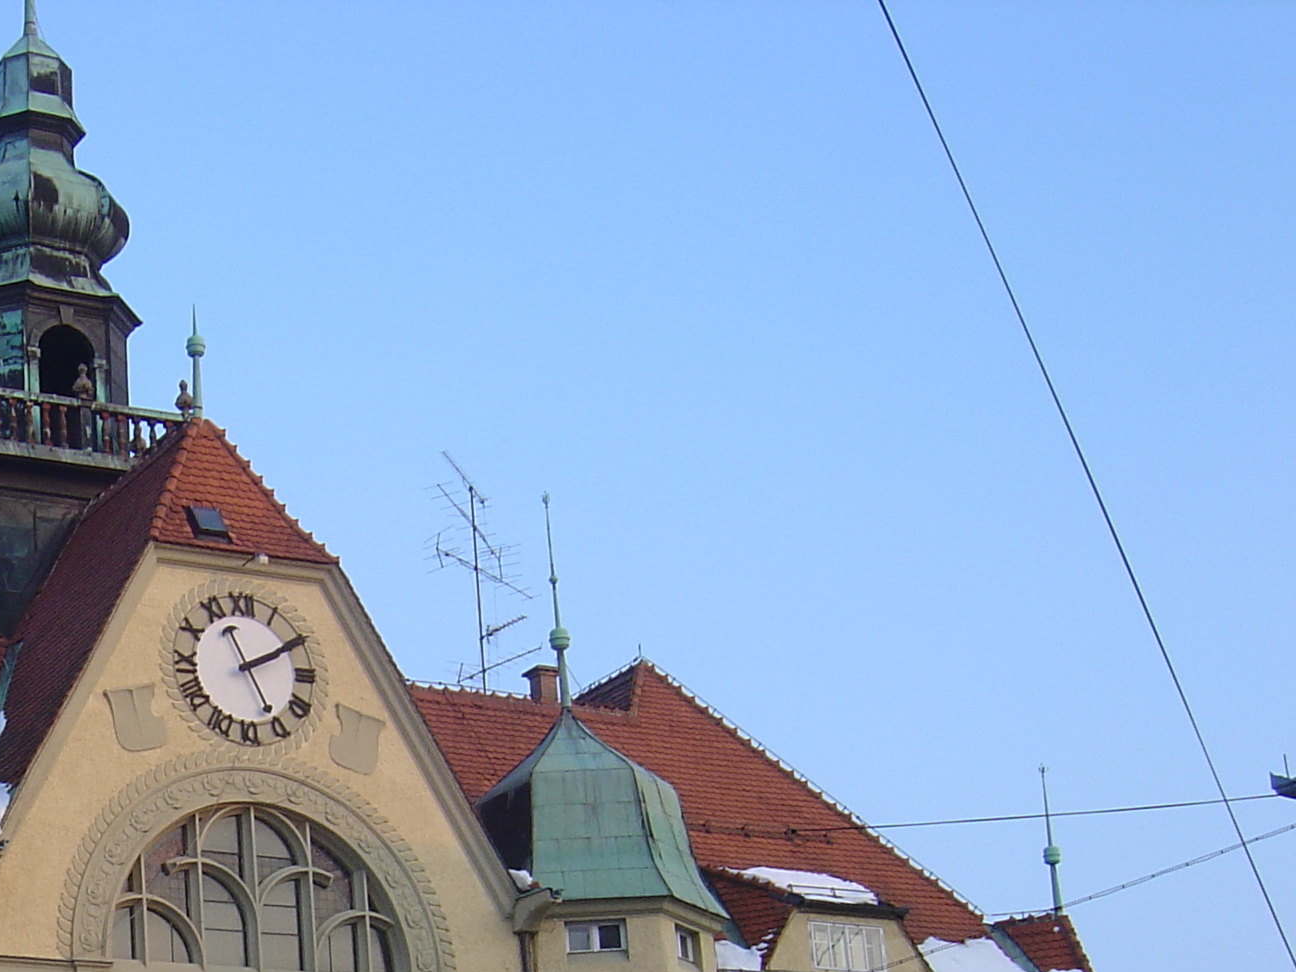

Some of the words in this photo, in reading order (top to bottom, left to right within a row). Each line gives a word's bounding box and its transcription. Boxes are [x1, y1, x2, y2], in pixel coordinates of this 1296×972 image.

[200, 595, 226, 623] XI
[229, 592, 255, 617] XII
[267, 607, 278, 626] I
[180, 617, 205, 641] X
[174, 649, 197, 674] IX
[294, 667, 315, 684] III
